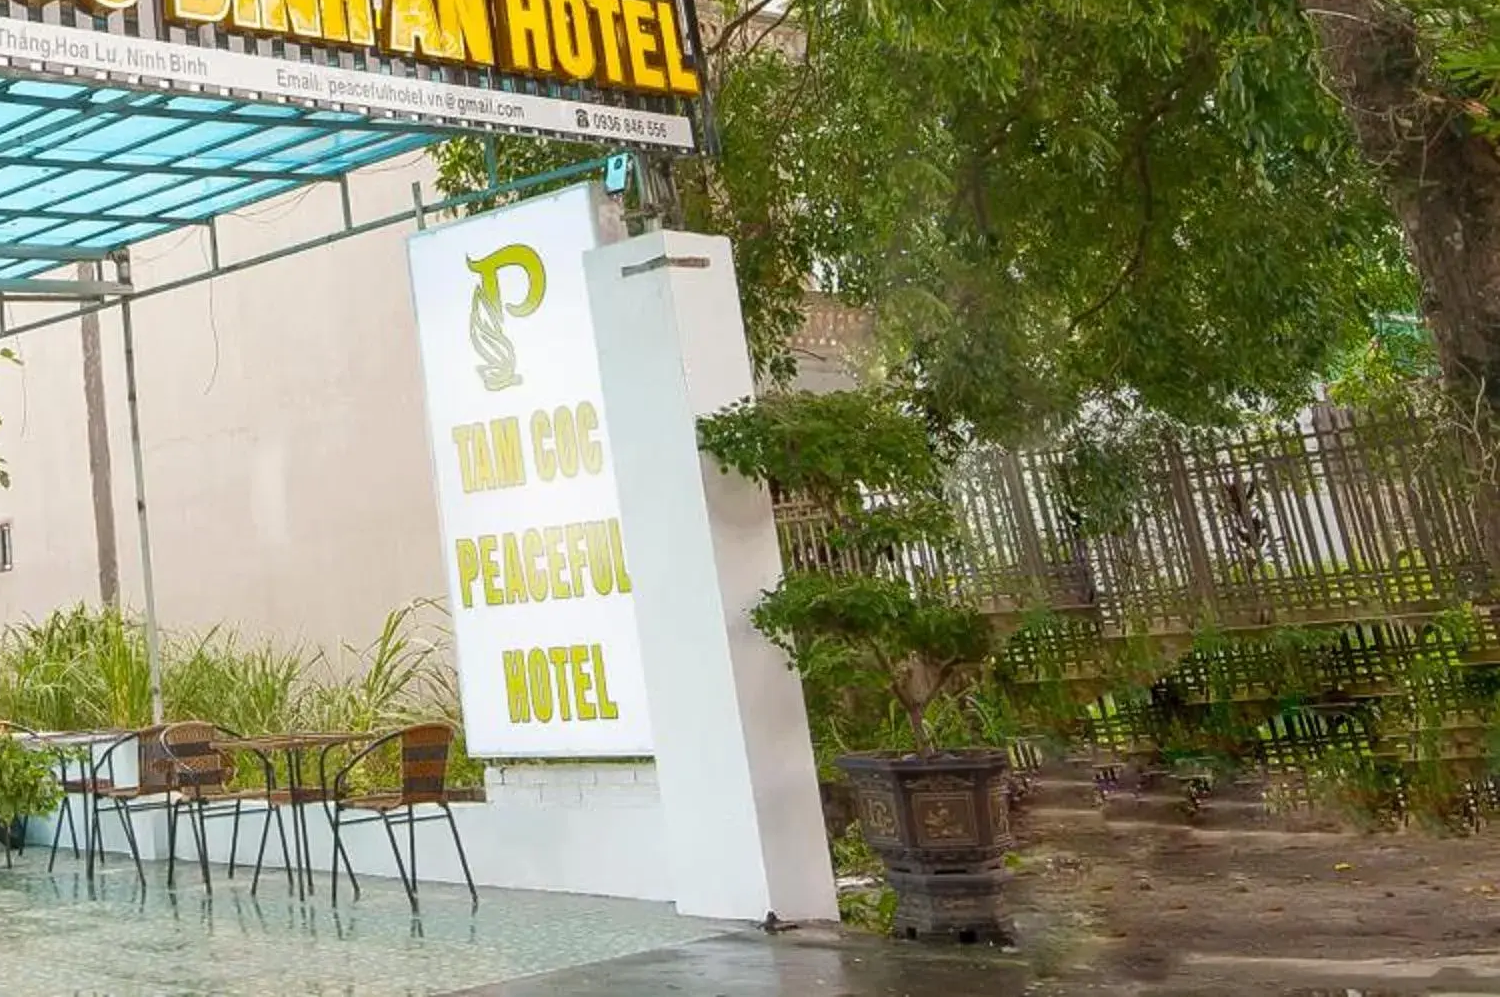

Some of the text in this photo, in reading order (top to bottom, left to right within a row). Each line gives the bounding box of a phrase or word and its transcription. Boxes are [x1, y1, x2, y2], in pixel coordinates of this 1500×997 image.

[126, 45, 166, 71] Ninh
[276, 68, 323, 93] Email:
[451, 400, 603, 494] TAM COC
[456, 516, 633, 608] PEACEFUL
[501, 642, 619, 723] HOTEL
